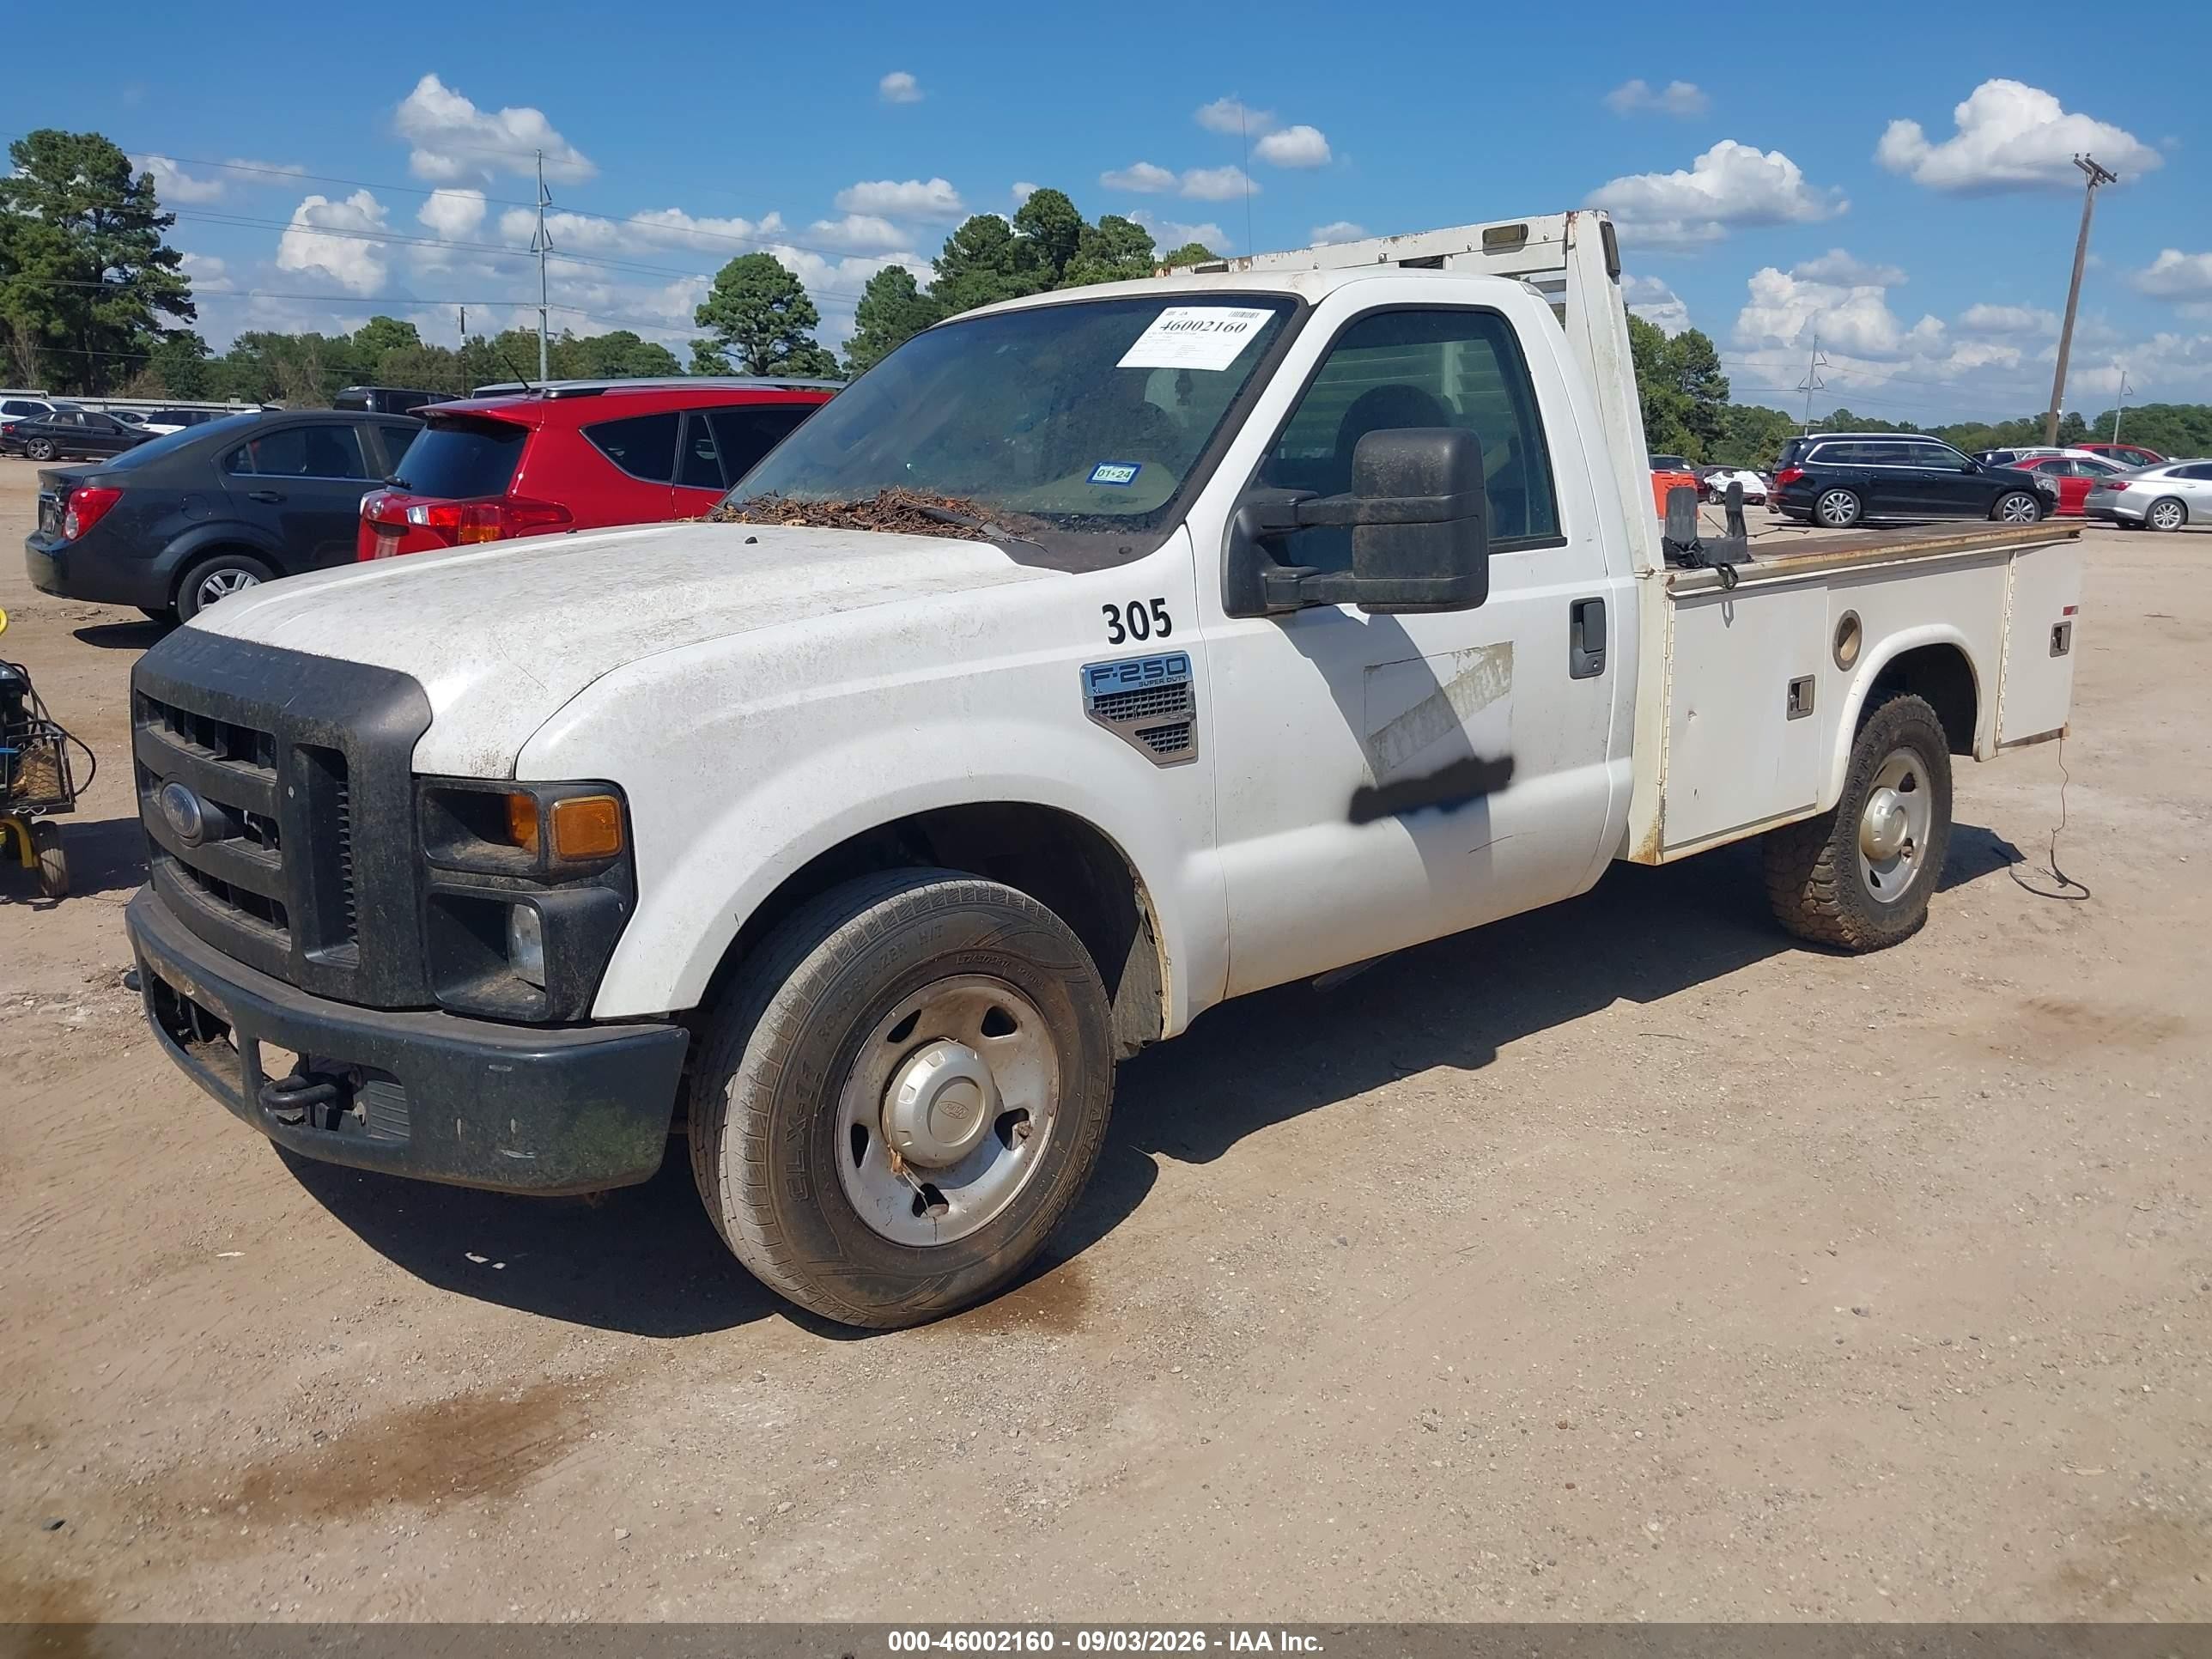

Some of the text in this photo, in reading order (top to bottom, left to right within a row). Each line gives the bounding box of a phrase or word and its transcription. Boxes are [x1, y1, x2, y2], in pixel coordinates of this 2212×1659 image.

[1160, 319, 1248, 334] 46002160
[1102, 597, 1172, 644] 305
[1090, 657, 1187, 687] F-250
[1138, 675, 1187, 688] SUPER DUTY
[941, 1102, 966, 1118] Ford
